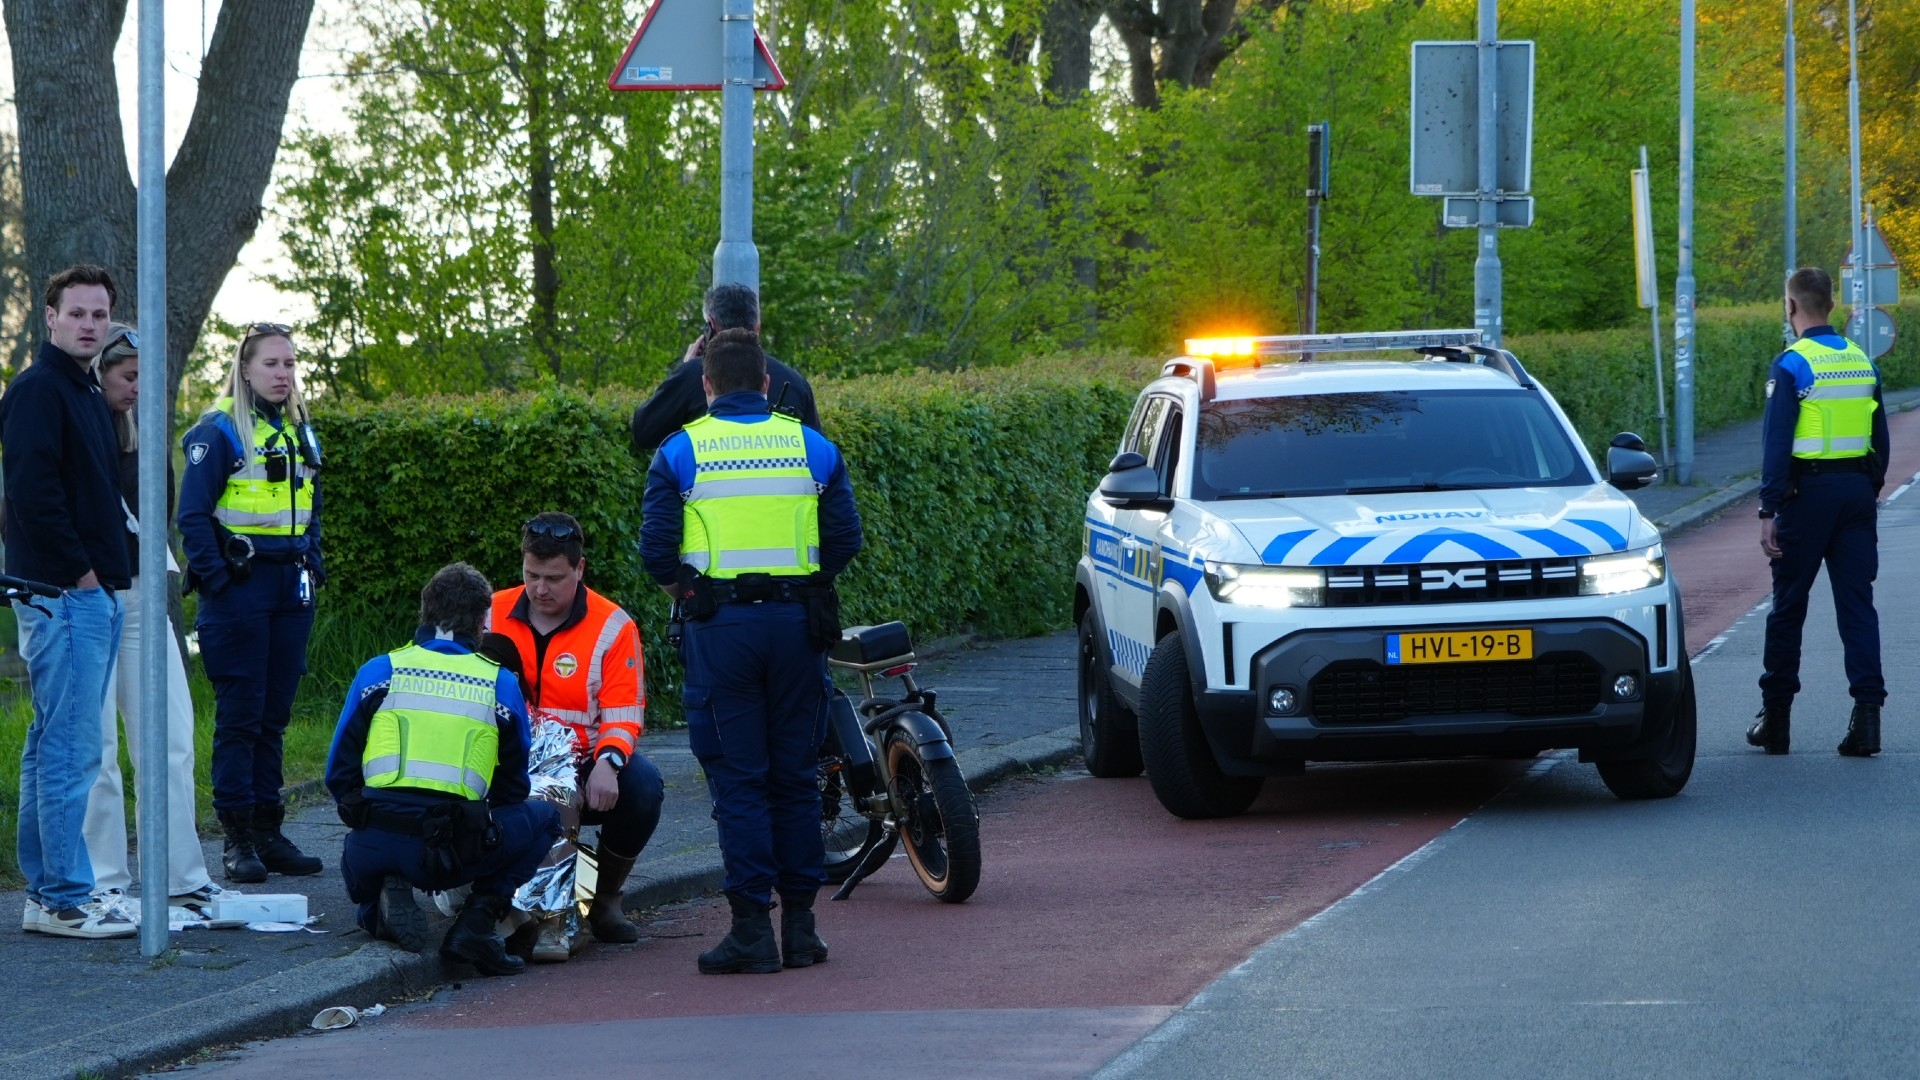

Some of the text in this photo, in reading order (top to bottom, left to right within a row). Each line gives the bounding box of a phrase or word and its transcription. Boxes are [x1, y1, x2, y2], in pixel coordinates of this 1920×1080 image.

[697, 435, 800, 453] HANDHAVING
[1411, 634, 1521, 658] HVL-19-B
[391, 677, 495, 704] HANDHAVING
